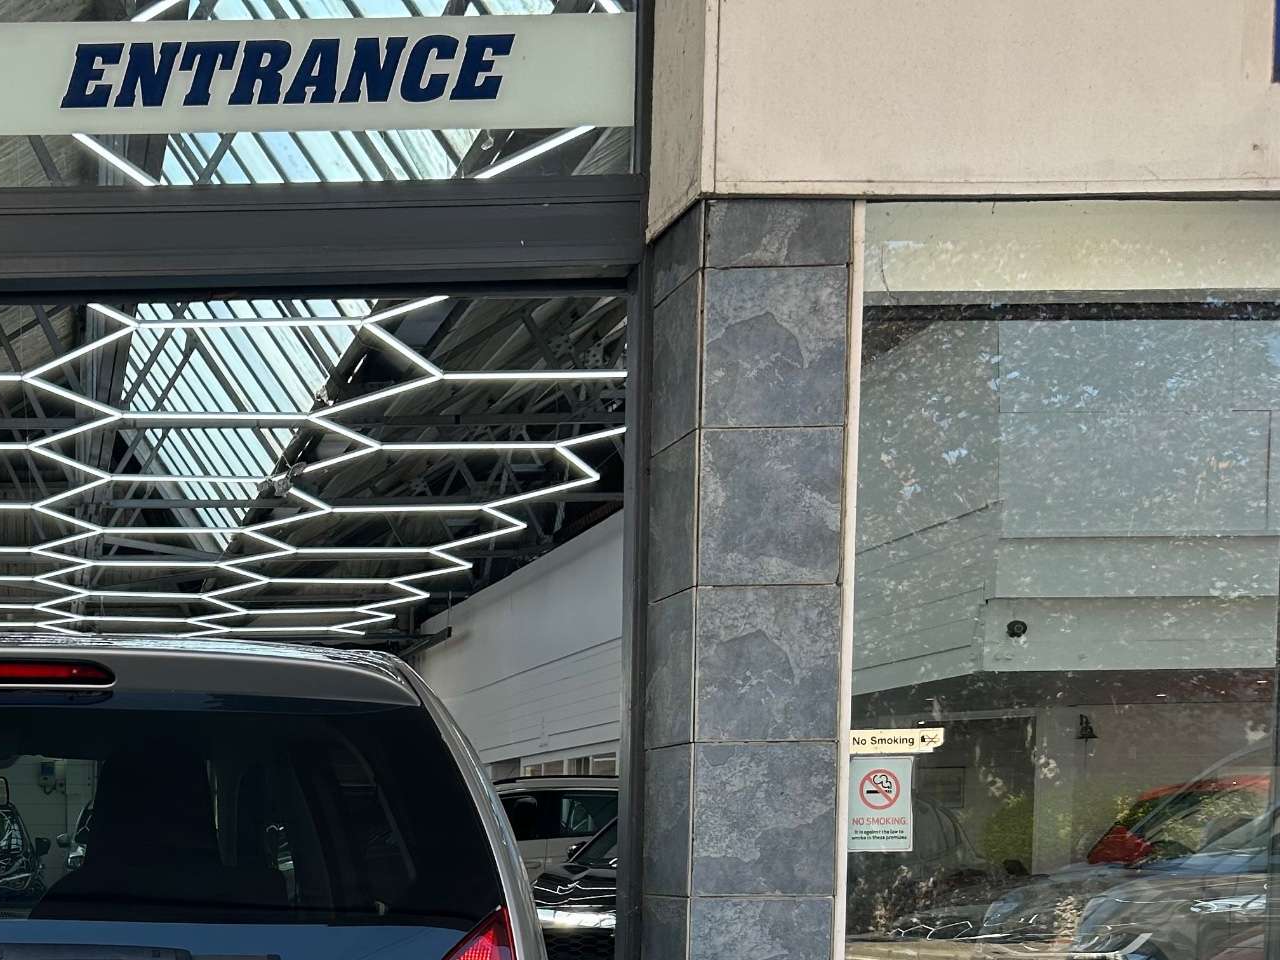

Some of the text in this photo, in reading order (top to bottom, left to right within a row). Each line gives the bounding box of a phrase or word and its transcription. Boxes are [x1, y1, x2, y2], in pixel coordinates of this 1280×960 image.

[60, 34, 516, 109] ENTRANCE
[852, 736, 915, 747] No Smoking
[852, 816, 906, 826] NO SMOKING
